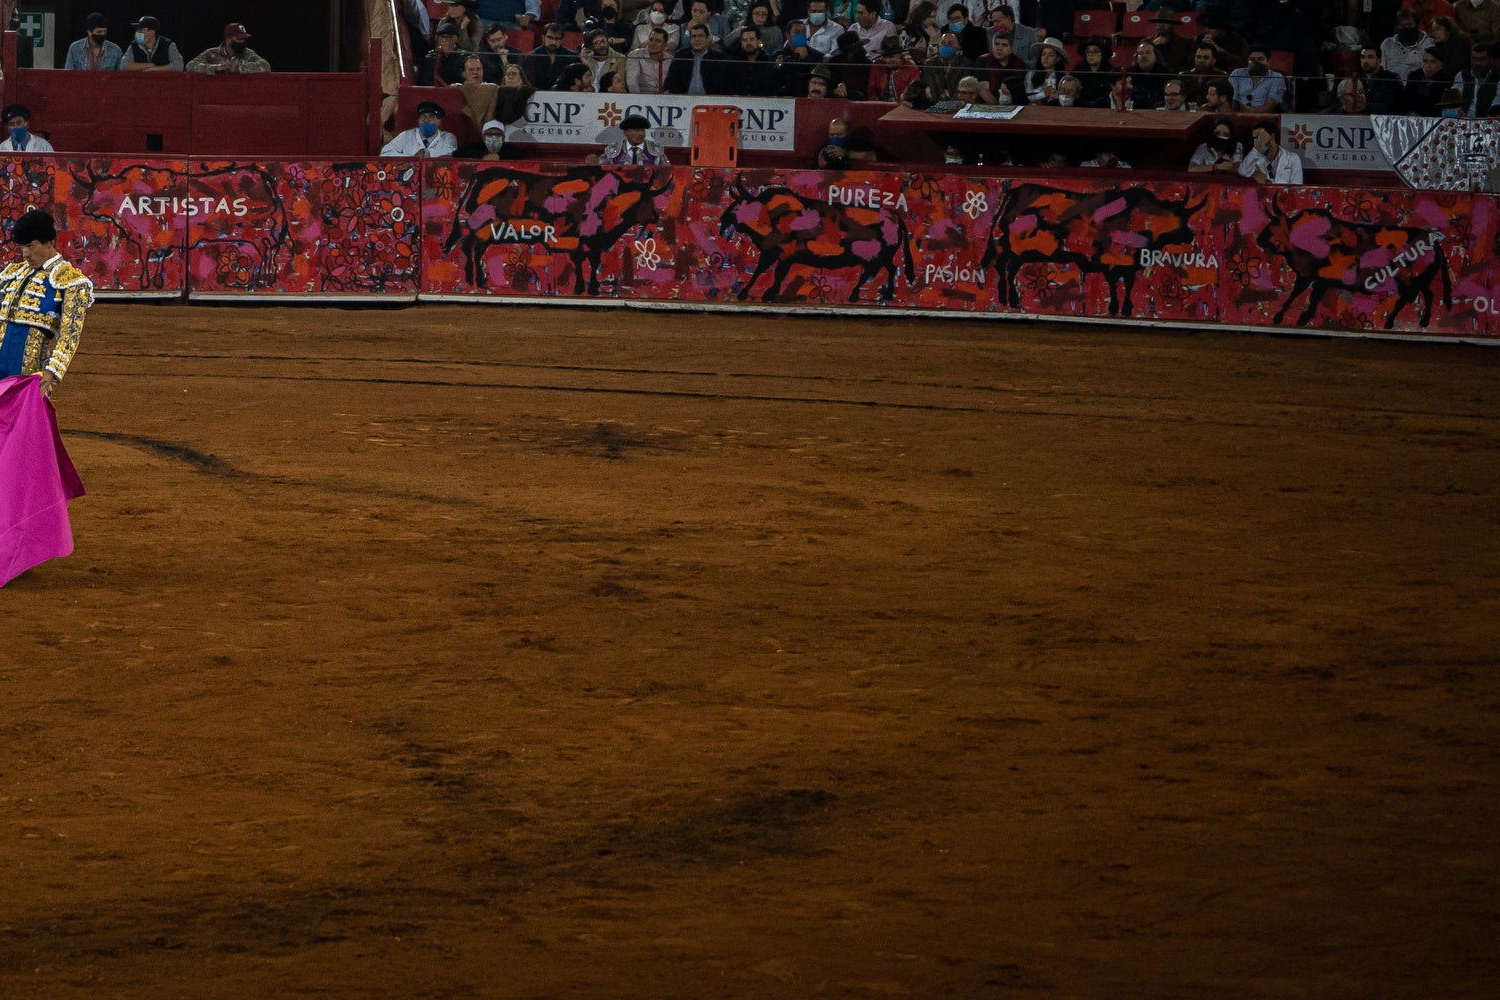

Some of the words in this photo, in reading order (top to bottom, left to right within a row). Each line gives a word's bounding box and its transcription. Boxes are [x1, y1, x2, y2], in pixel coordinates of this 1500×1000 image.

[523, 101, 582, 124] GNP
[522, 127, 581, 136] SEGUROS
[742, 134, 784, 142] GUROS
[1315, 126, 1375, 149] GNP
[1315, 153, 1376, 162] SEGUROS
[117, 195, 248, 217] ARTISTAS
[827, 184, 909, 213] PUREZA
[490, 220, 559, 243] VALOR
[1139, 247, 1220, 270] BRAVURA
[1363, 230, 1446, 291] CULTURA
[925, 261, 986, 285] PASIÓN
